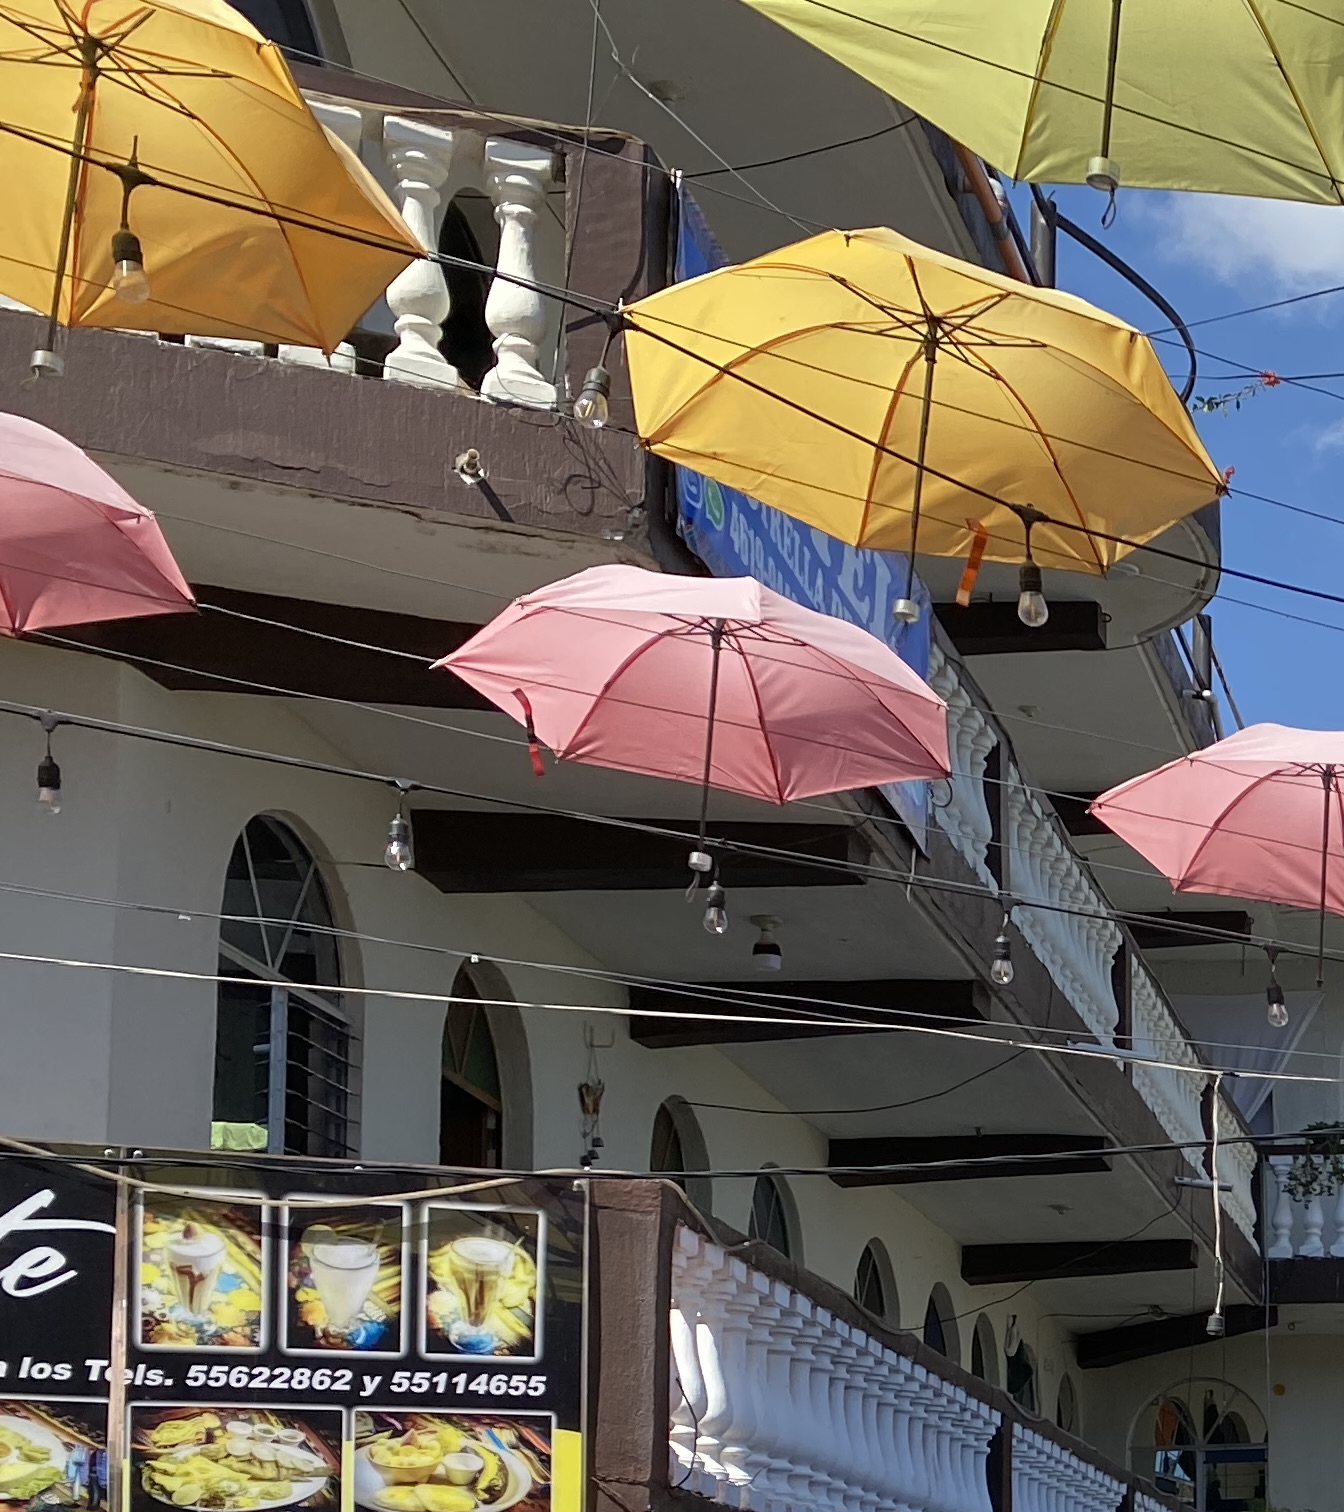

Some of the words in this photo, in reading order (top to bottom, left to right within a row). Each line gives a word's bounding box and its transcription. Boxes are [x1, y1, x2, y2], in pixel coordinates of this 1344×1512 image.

[18, 1357, 72, 1381] los
[185, 1365, 352, 1391] 55622862
[360, 1375, 382, 1397] y
[390, 1371, 547, 1396] 55114655
